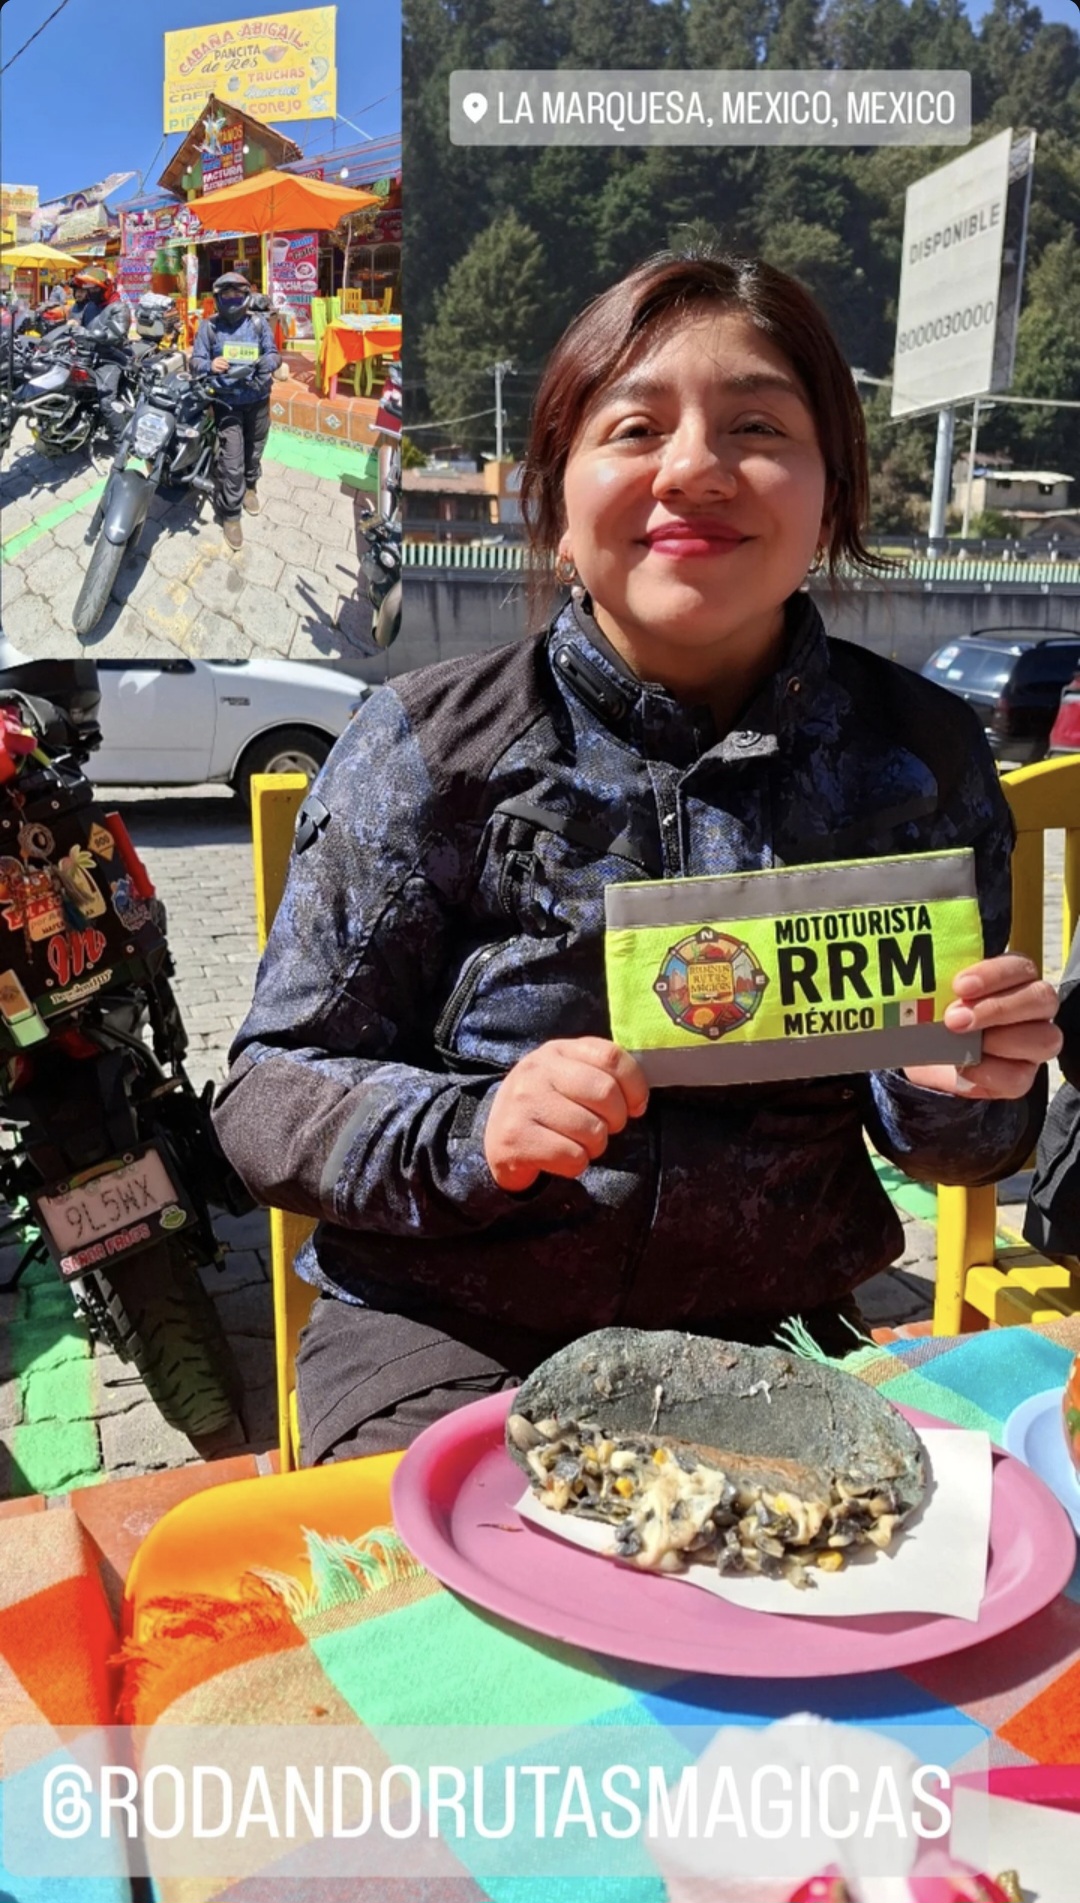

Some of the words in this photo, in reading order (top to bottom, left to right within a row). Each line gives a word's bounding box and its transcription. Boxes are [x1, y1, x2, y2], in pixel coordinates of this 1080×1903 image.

[178, 30, 234, 76] CABAÑA
[240, 22, 305, 51] ABIGAIL
[201, 62, 219, 74] de
[224, 58, 258, 72] Res
[213, 45, 261, 61] PANCITA
[247, 66, 306, 82] TRUCHAS
[908, 202, 1000, 265] DISPONIBLE
[897, 300, 995, 354] 8000030000
[701, 930, 714, 940] N
[775, 905, 932, 945] MOTOTURISTA
[777, 933, 937, 1007] RRM
[783, 1008, 875, 1036] MÉXICO
[65, 1174, 157, 1239] 9L5WX
